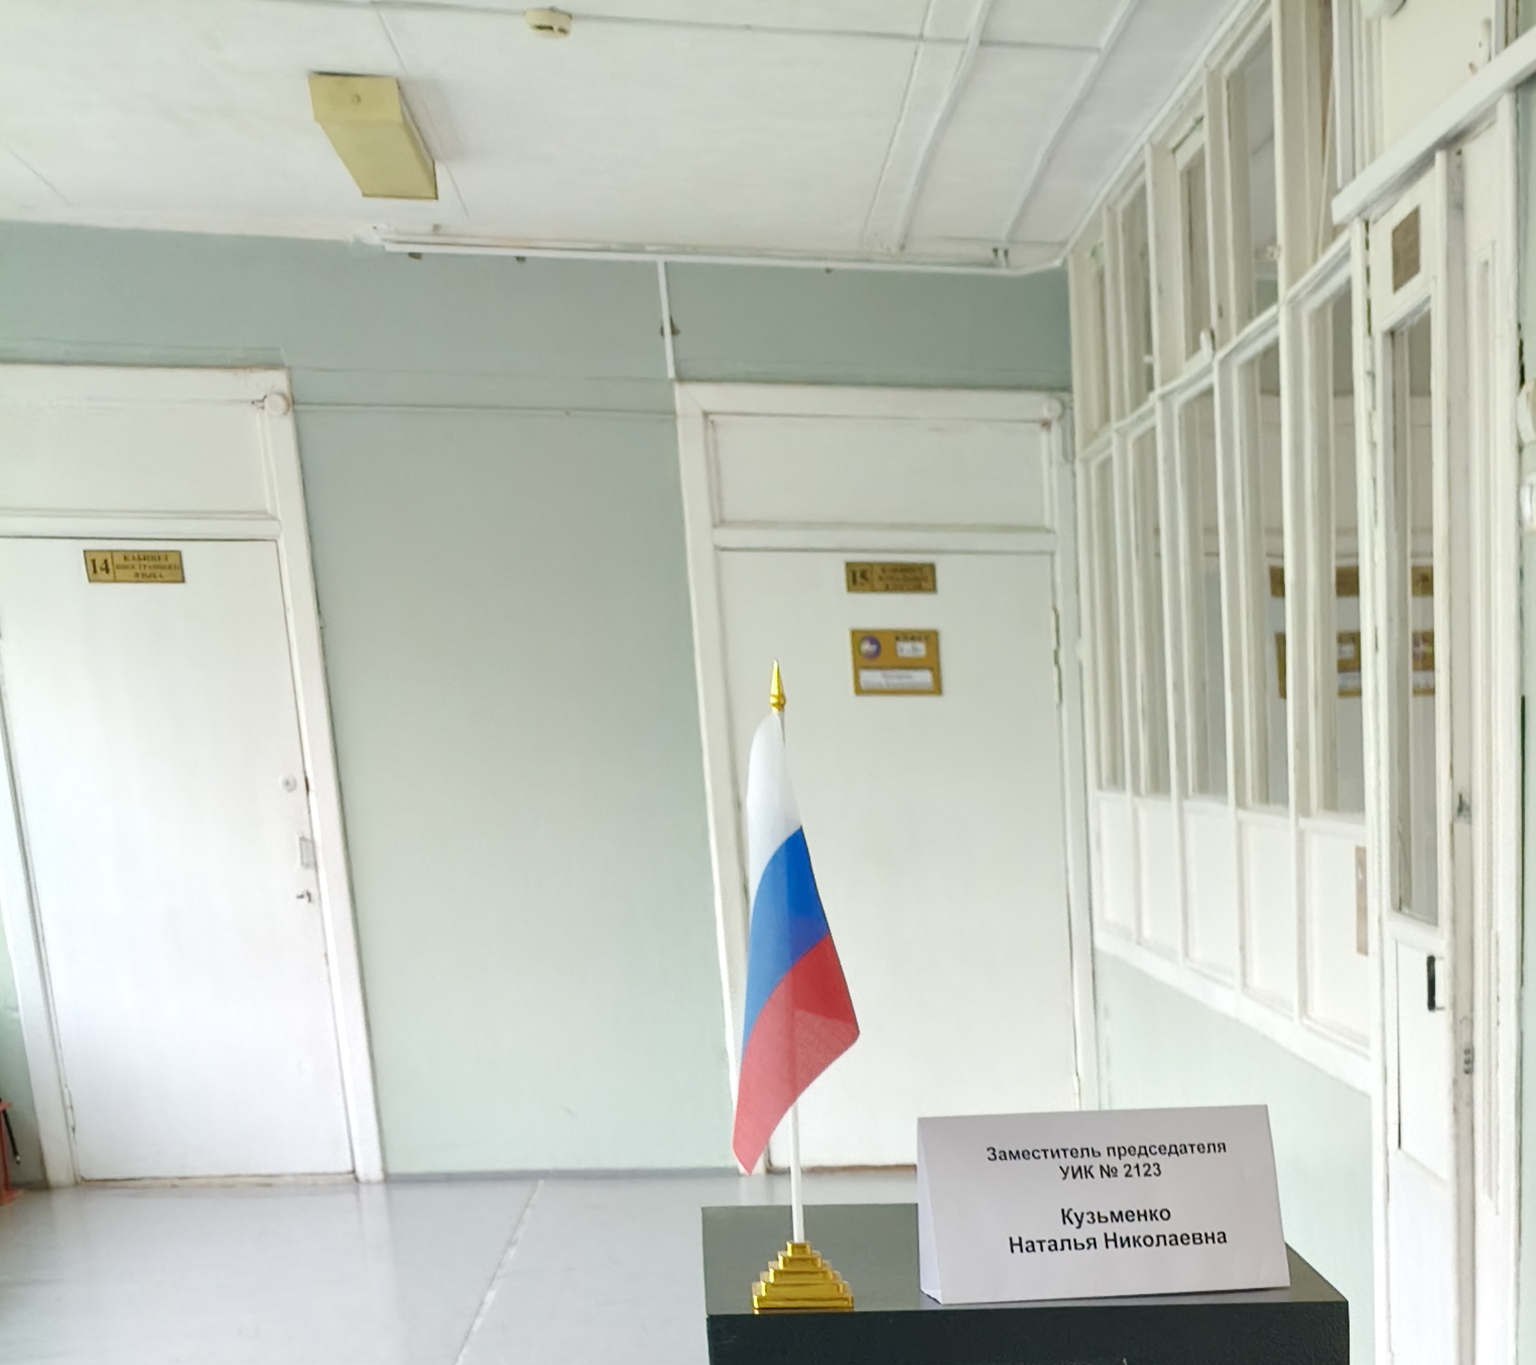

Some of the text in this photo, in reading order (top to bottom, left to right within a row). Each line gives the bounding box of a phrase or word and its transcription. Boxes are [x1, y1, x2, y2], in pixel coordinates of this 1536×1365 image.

[90, 558, 110, 575] 14
[987, 1142, 1227, 1161] Заместитель председателя
[1059, 1162, 1162, 1180] УИК № 2123
[1061, 1208, 1171, 1229] Кузьменко
[1009, 1231, 1227, 1254] Наталья Николаевна
